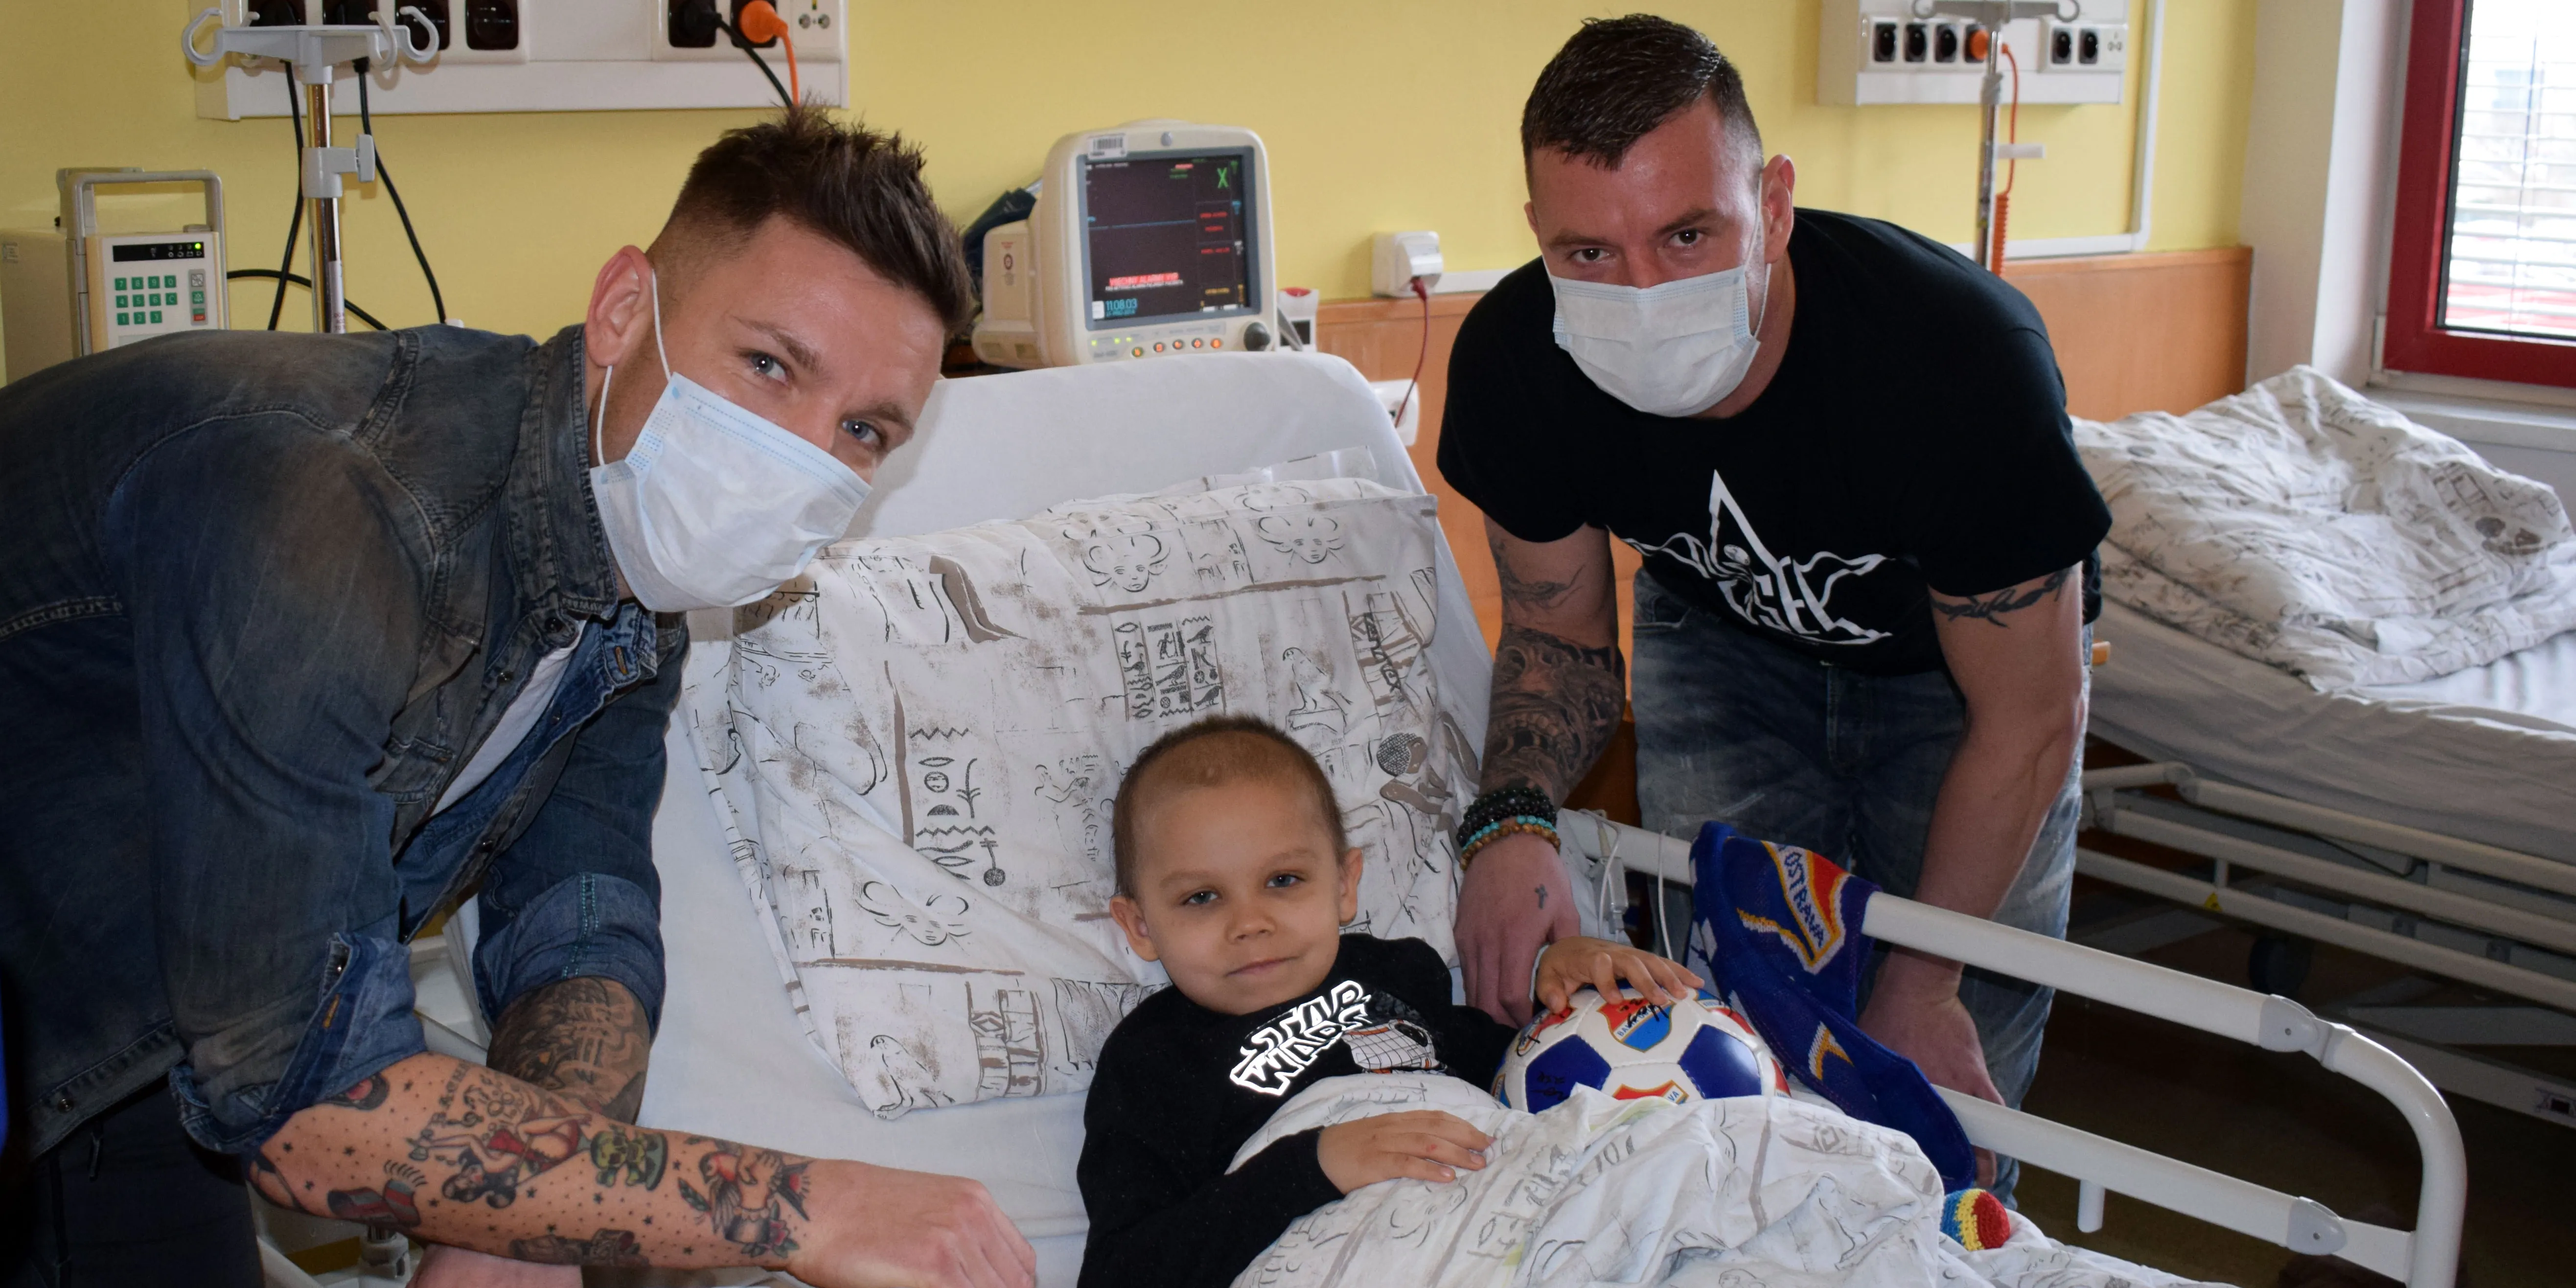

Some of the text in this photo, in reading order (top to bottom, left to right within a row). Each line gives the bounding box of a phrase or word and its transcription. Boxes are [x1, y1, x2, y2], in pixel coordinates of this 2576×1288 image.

[169, 295, 175, 303] C
[1229, 1003, 1372, 1096] WARS
[1240, 980, 1372, 1058] STAR
